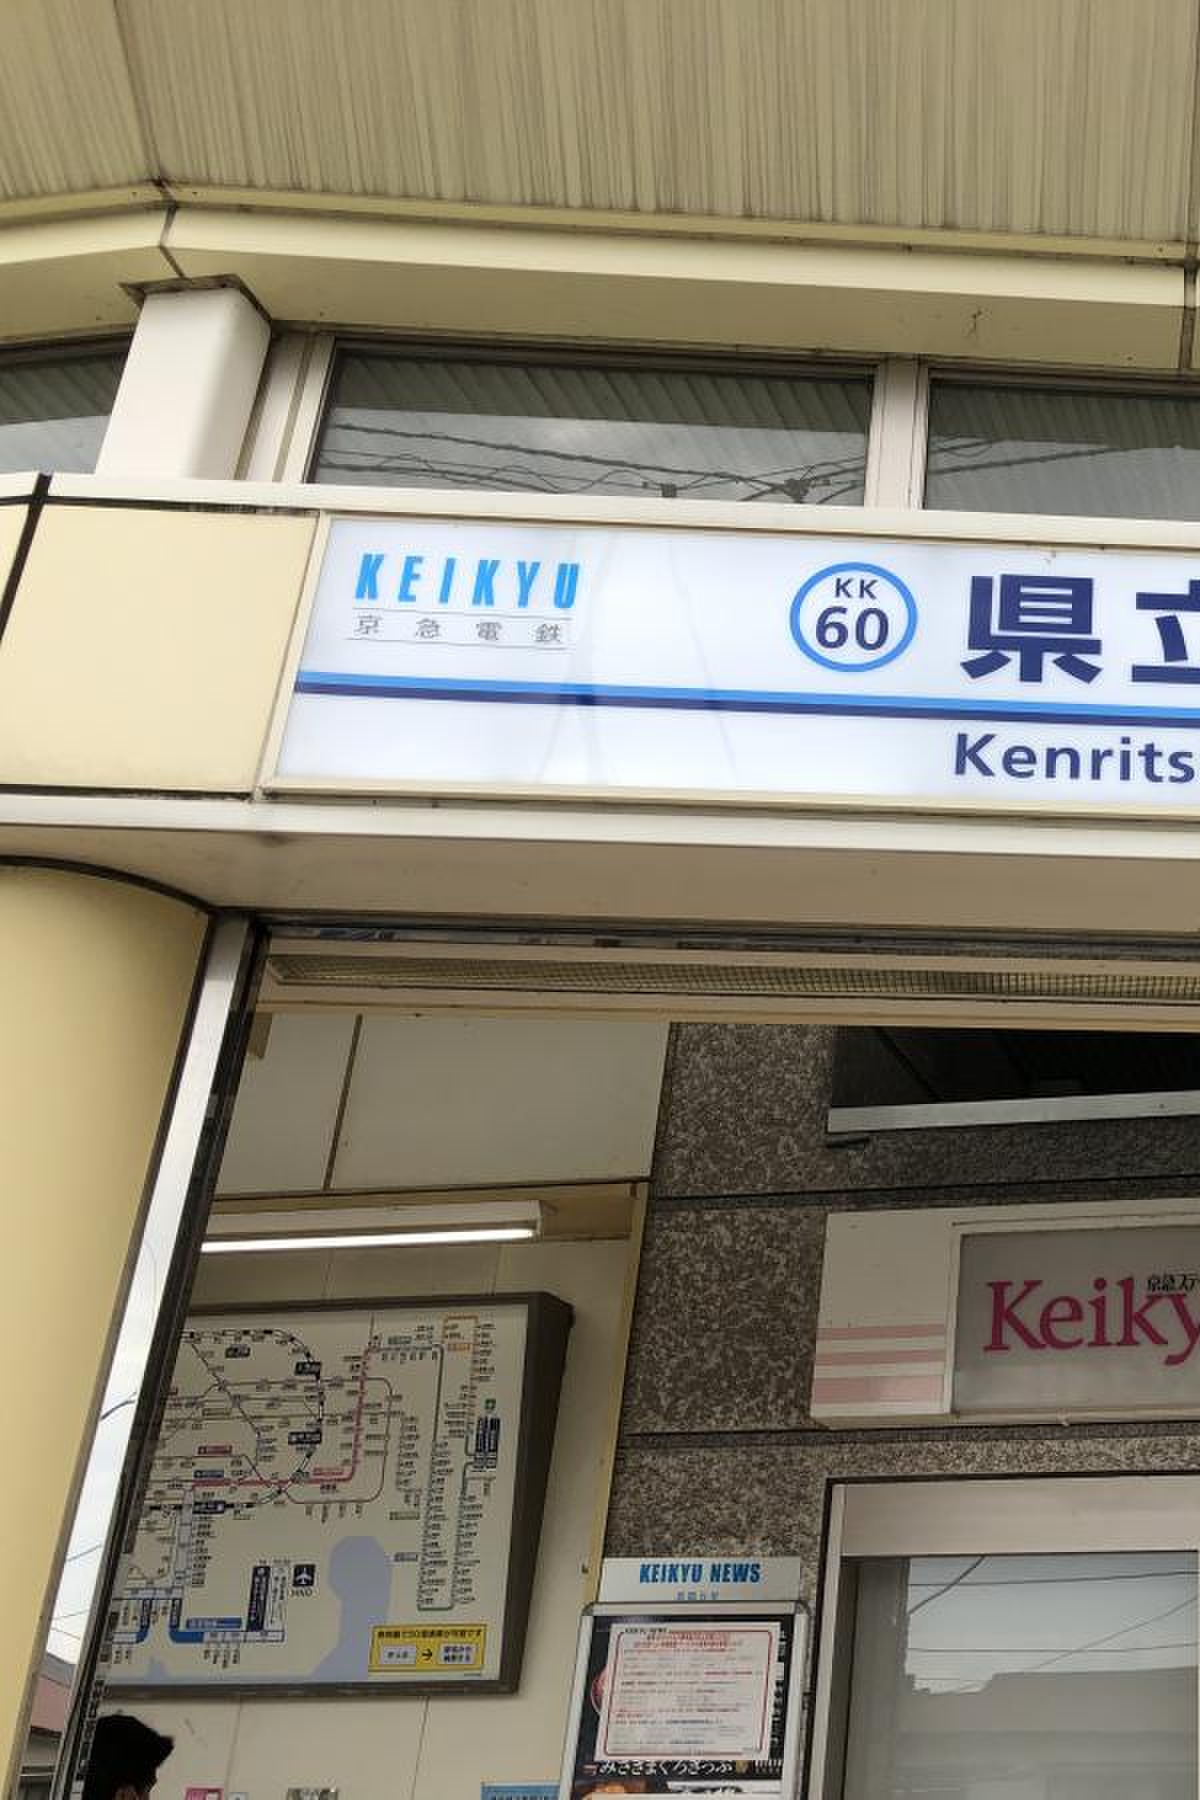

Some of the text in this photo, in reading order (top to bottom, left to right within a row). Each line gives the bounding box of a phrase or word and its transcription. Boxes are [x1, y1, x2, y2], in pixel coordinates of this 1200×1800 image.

[354, 553, 580, 610] KEIKYU
[833, 576, 878, 601] KK
[353, 614, 564, 644] 京急電鉄
[813, 607, 890, 651] 60
[639, 1563, 761, 1583] KEIKYU NEWS
